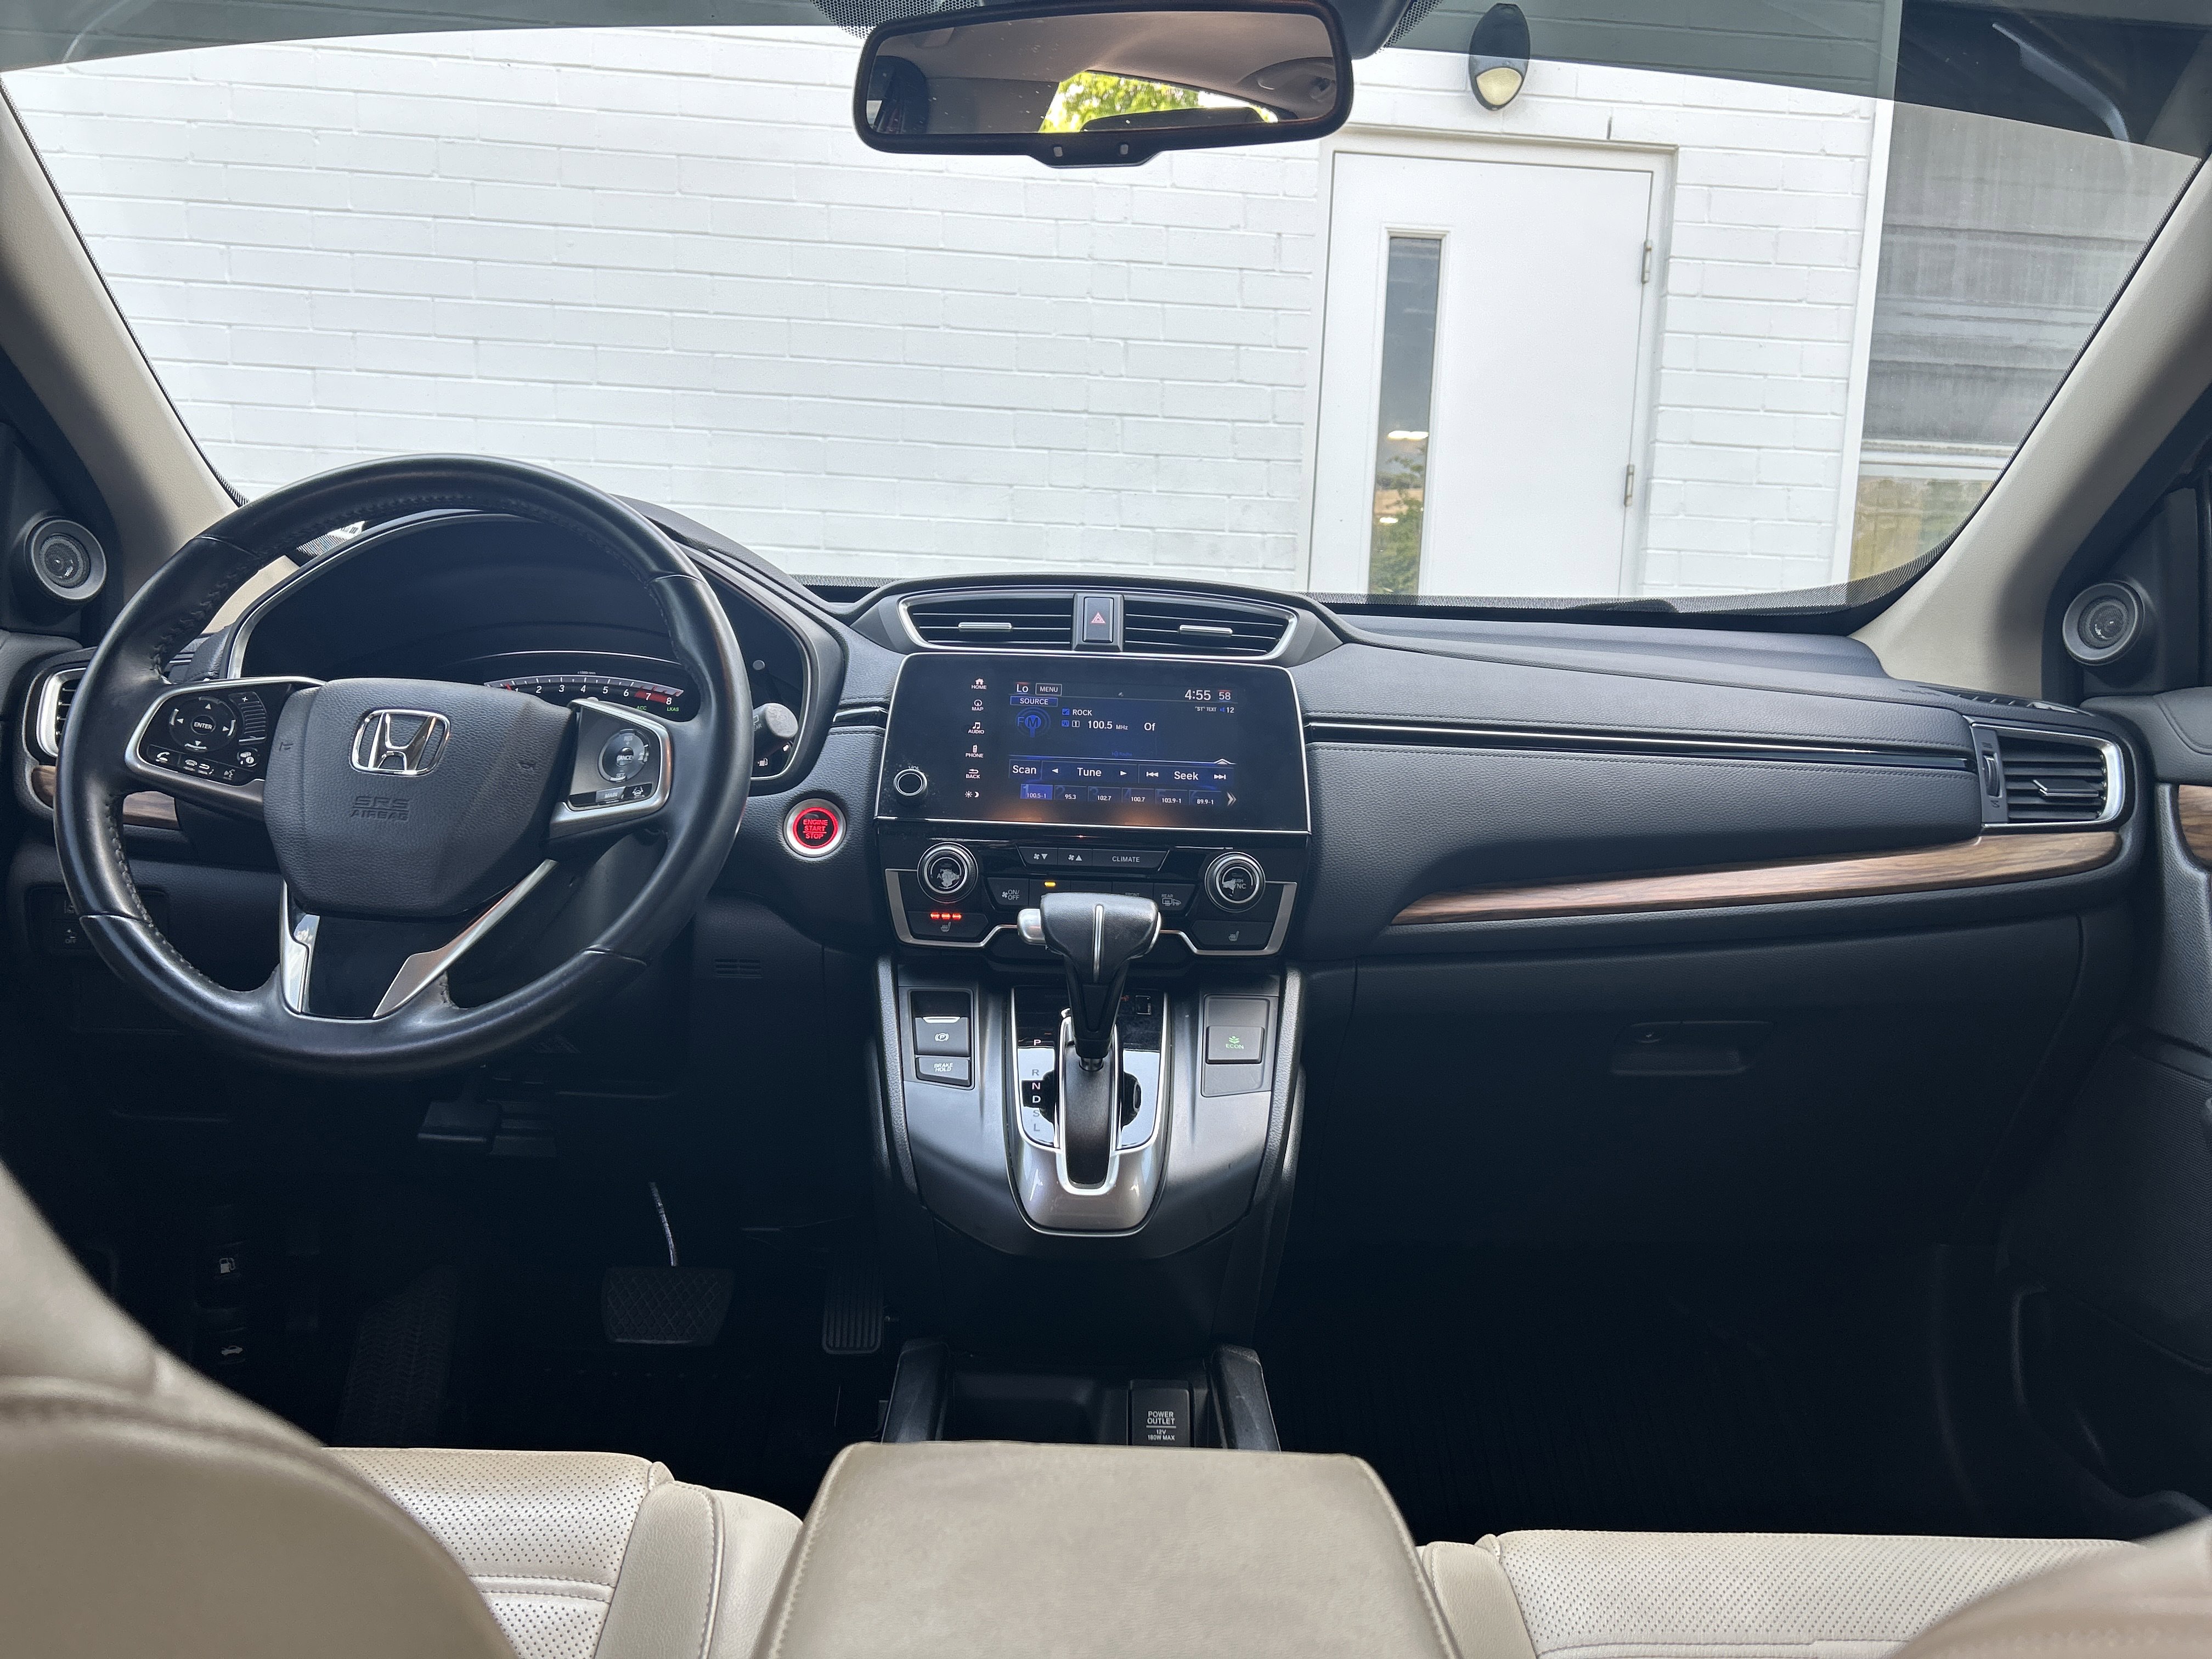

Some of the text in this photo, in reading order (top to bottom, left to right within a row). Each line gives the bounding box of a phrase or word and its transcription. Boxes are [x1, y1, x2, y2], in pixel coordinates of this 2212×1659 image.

[1016, 684, 1029, 693] Lo
[1184, 690, 1231, 701] 4:55 58
[194, 721, 213, 730] ENTER
[1088, 720, 1113, 730] 100.5
[1144, 723, 1156, 731] Of
[1012, 765, 1036, 774] Scan
[1077, 768, 1102, 776] Tune
[1174, 771, 1199, 780] Seek
[354, 796, 409, 808] SRS
[350, 810, 409, 821] AIRBAG
[1034, 1124, 1040, 1132] L
